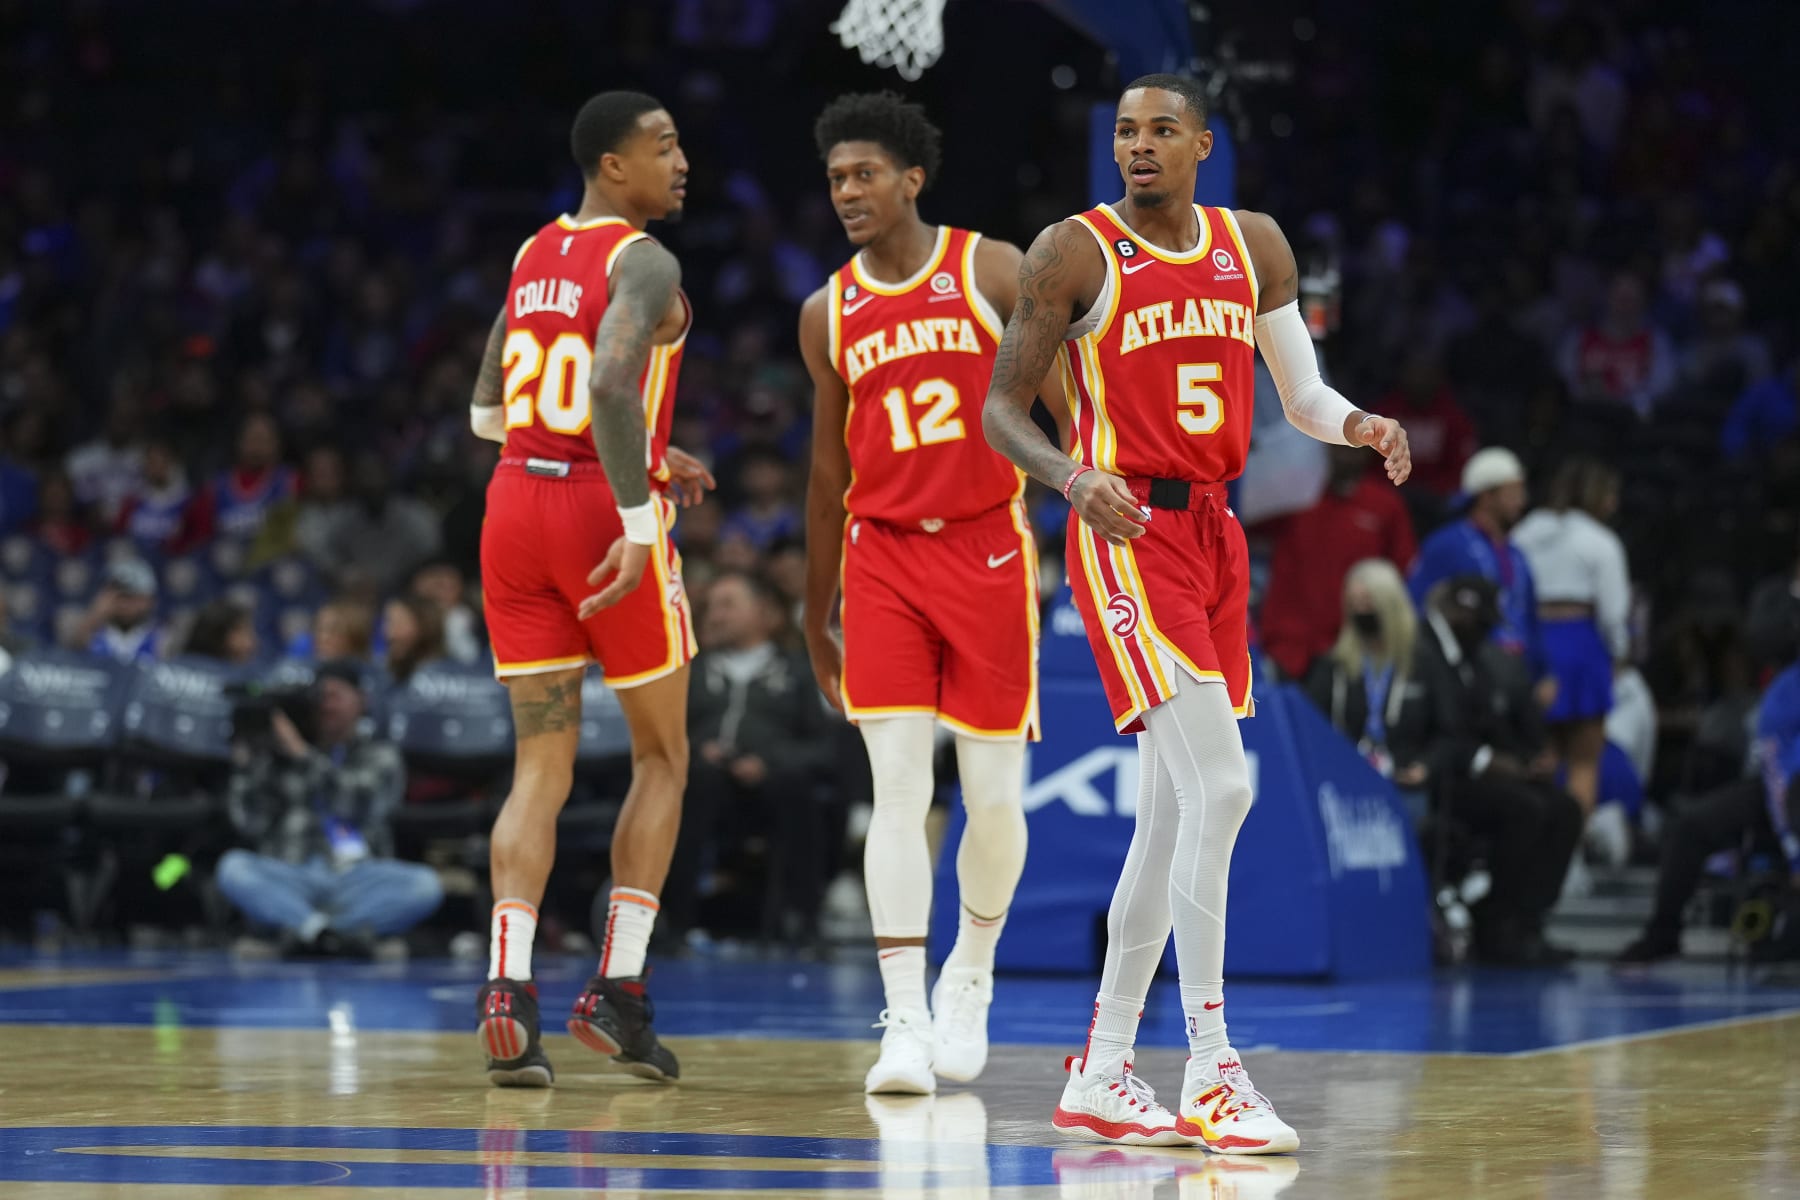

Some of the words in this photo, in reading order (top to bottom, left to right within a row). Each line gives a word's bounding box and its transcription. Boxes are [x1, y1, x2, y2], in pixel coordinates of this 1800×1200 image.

[1118, 240, 1135, 257] 6
[515, 278, 583, 319] COLLINS
[1119, 298, 1255, 356] ATLANTA
[501, 329, 594, 436] 20
[845, 317, 982, 387] ATLANTA
[881, 377, 967, 452] 12
[1176, 362, 1225, 434] 5
